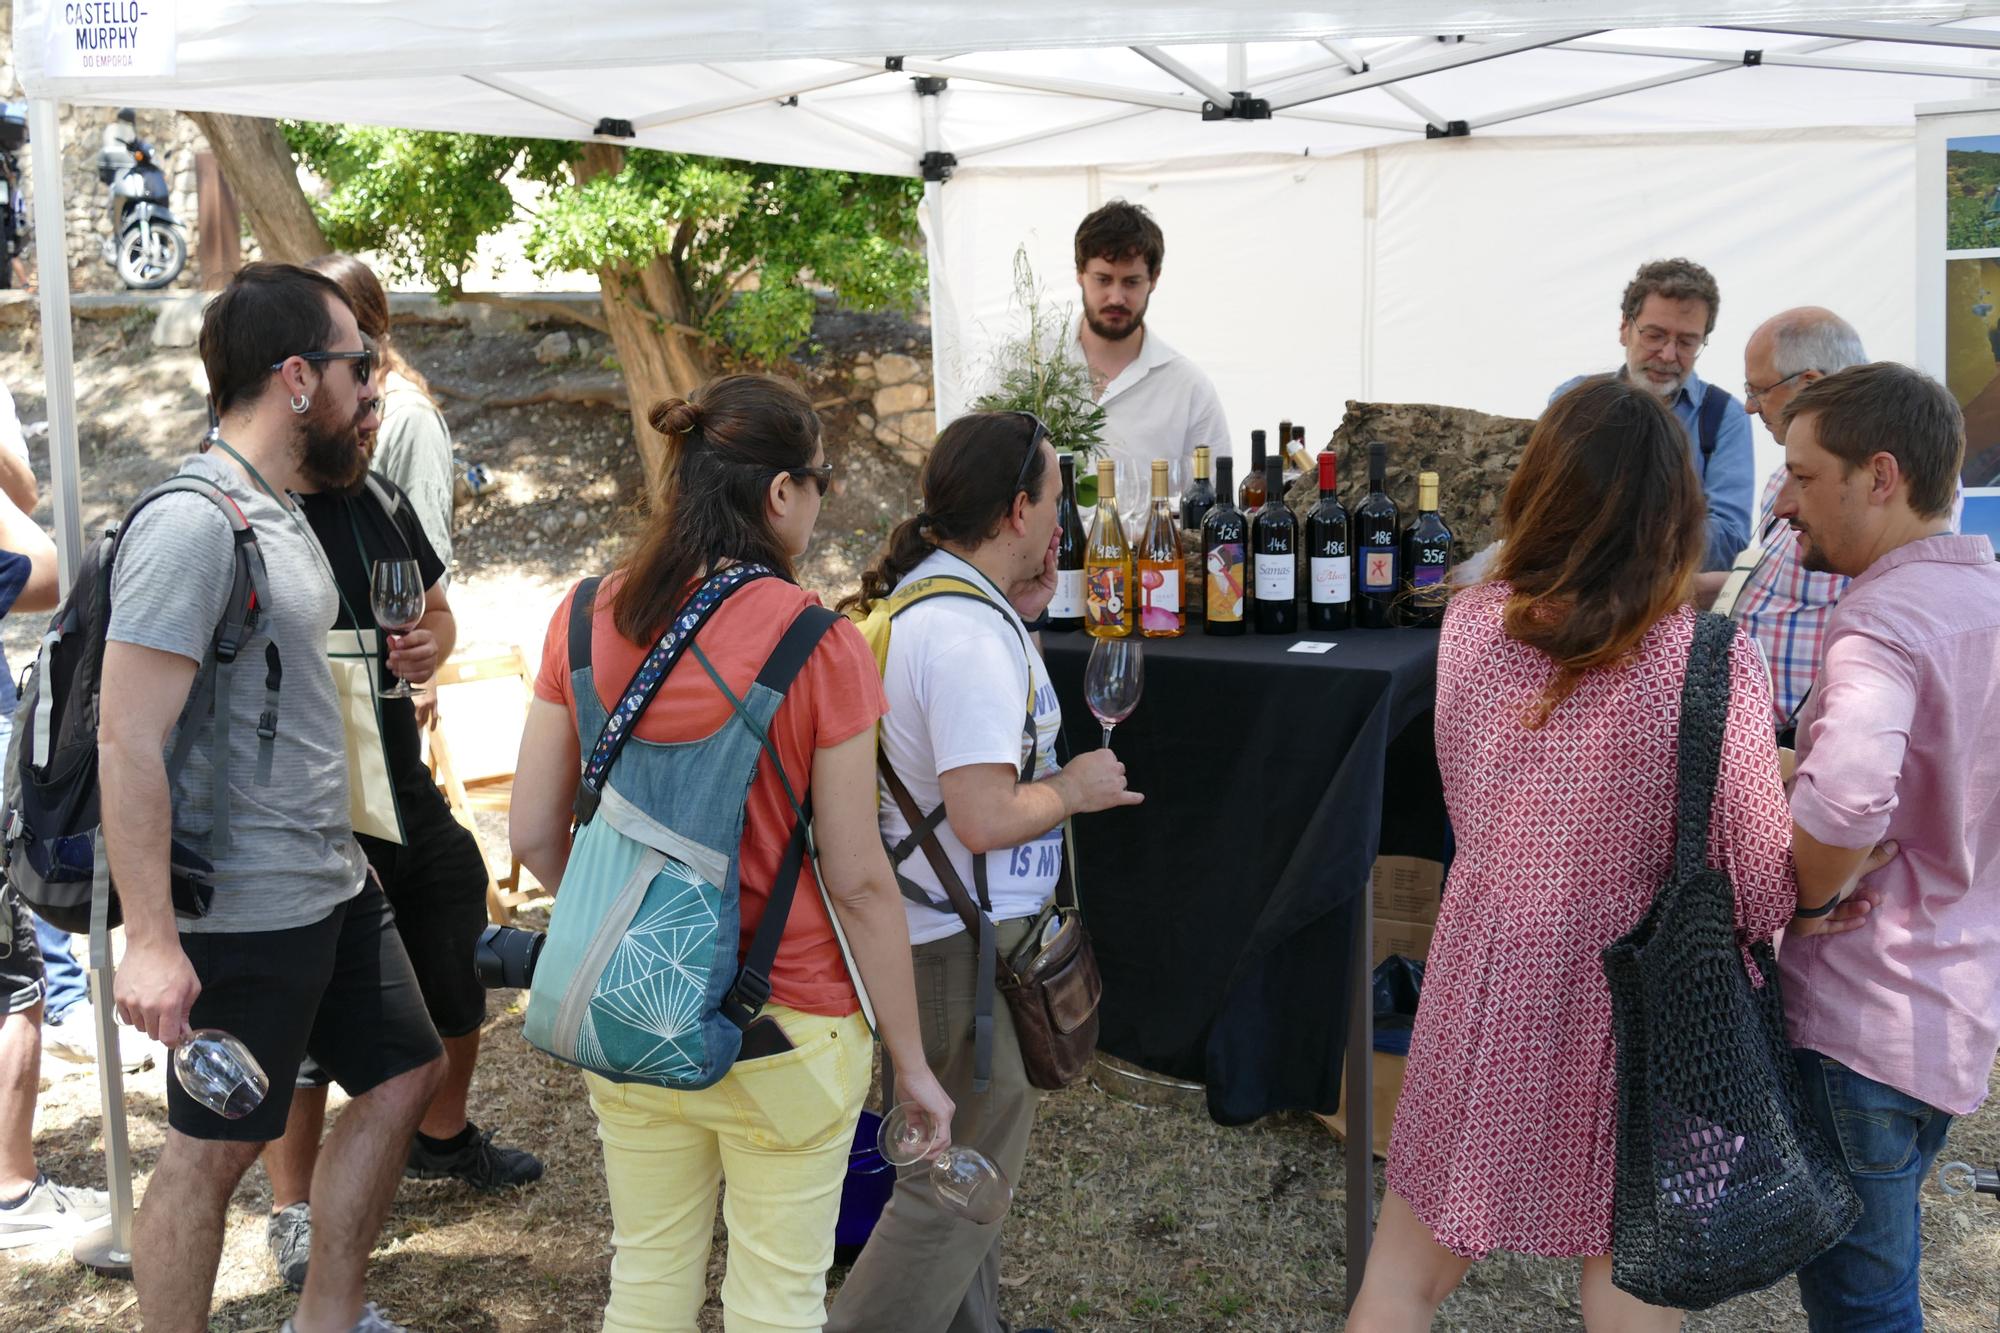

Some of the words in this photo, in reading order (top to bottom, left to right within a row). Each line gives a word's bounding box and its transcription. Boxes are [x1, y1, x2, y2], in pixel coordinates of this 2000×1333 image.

[76, 27, 137, 50] MURPHY
[83, 55, 94, 68] DO
[1217, 526, 1240, 540] 12€
[1370, 530, 1392, 545] 18€
[1267, 537, 1288, 551] 14€
[1322, 540, 1345, 556] 18€
[1150, 550, 1172, 564] 12€
[1422, 548, 1446, 564] 35€
[1009, 844, 1032, 878] IS
